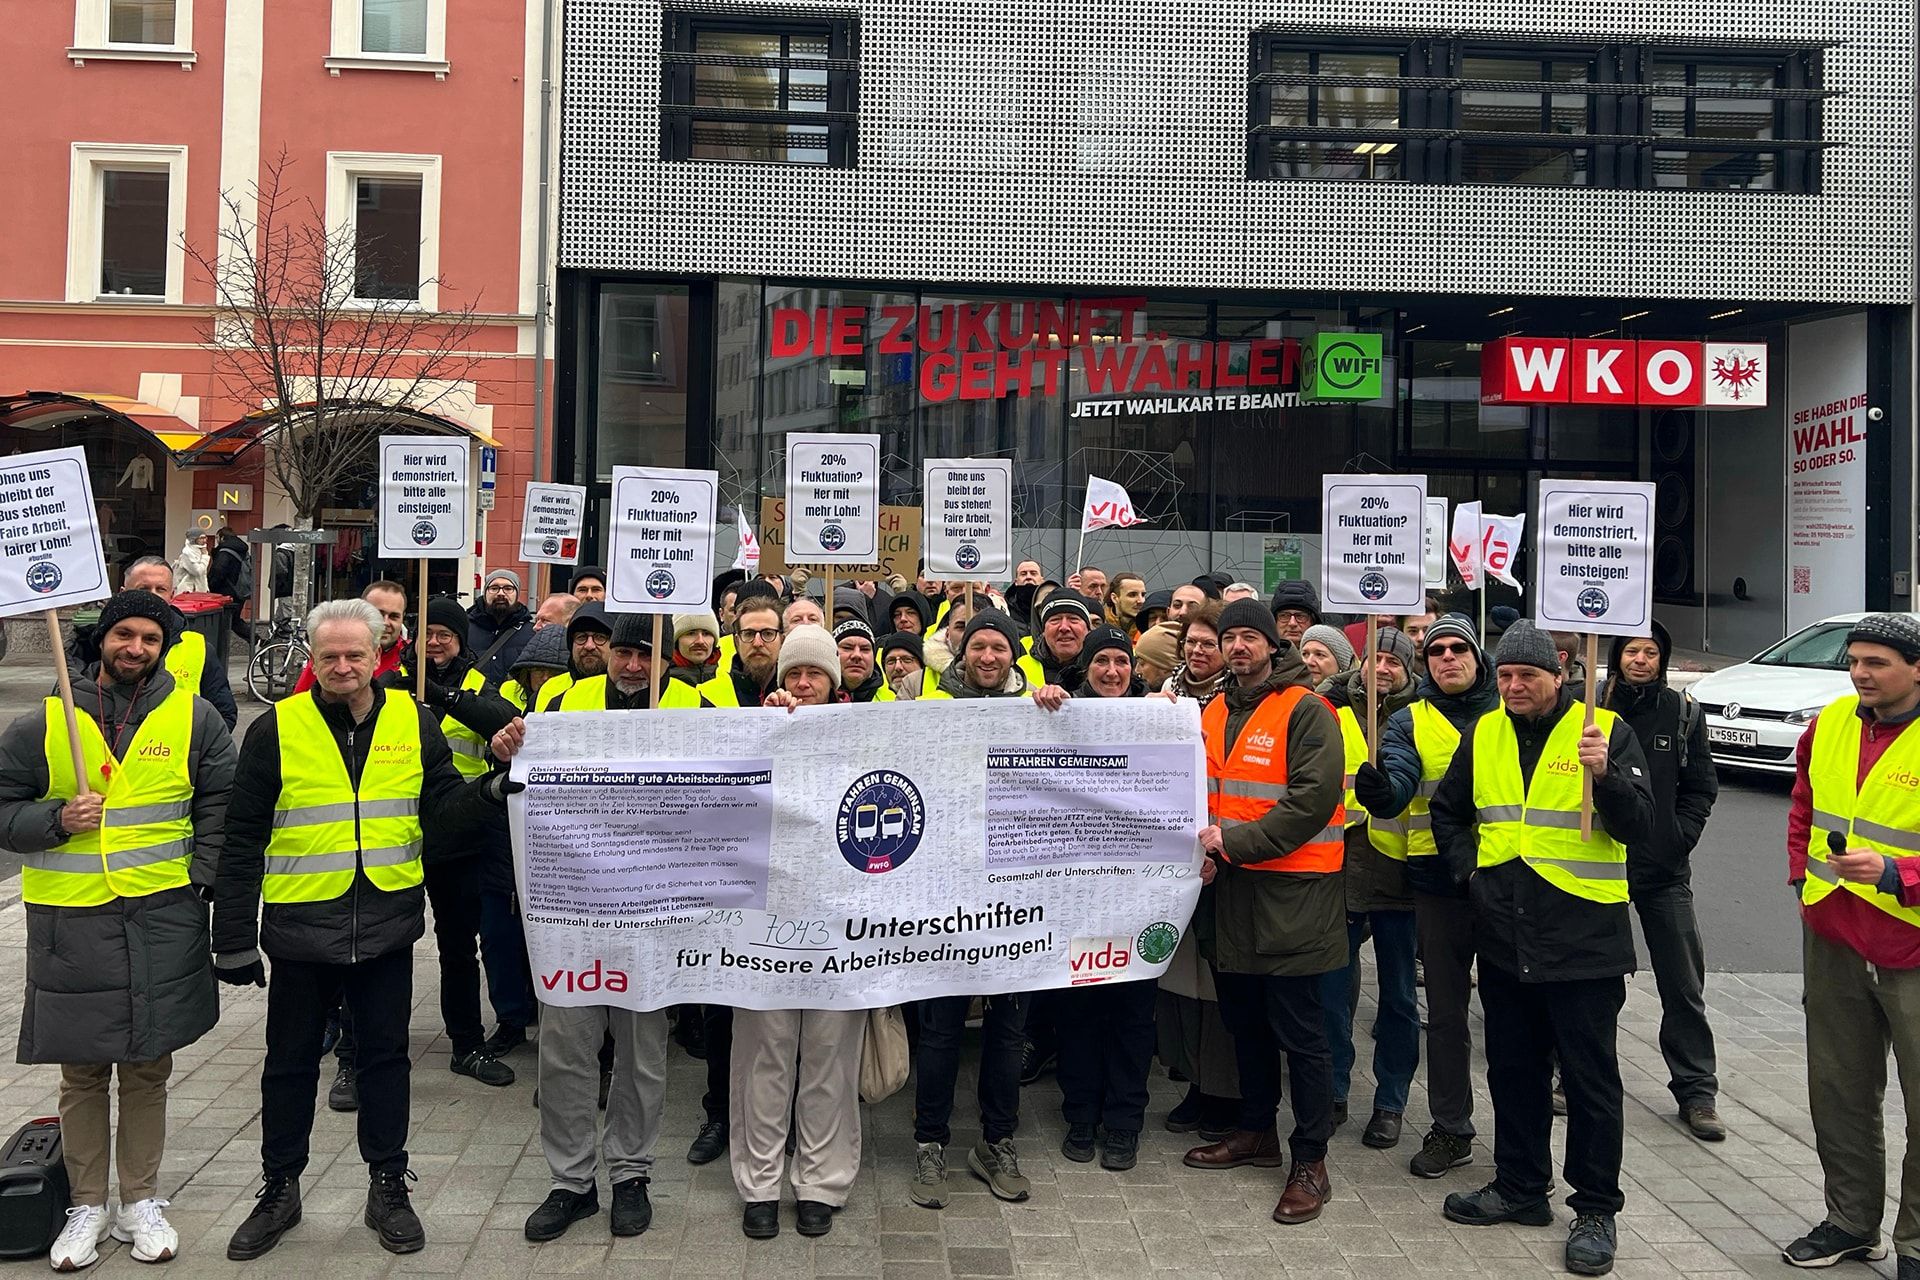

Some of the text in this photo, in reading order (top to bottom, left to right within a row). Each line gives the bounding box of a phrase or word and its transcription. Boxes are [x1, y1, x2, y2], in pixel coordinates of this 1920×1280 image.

[772, 296, 1147, 357] DIE ZUKUNFT
[1334, 358, 1380, 374] WIFI
[1510, 346, 1693, 396] WKO
[920, 349, 1067, 402] GEHT
[1070, 400, 1124, 418] JETZT
[1794, 393, 1868, 425] SIE HABEN DIE
[1794, 415, 1868, 456] WAHL.
[404, 454, 446, 466] Hier wird
[820, 454, 846, 466] 20%
[1794, 448, 1856, 474] SO ODER SO.
[28, 468, 50, 480] uns
[392, 470, 458, 482] demonstriert,
[801, 471, 862, 482] Fluktuation?
[948, 472, 986, 482] Ohne uns
[0, 486, 54, 504] bleibt der
[223, 490, 240, 505] N
[404, 486, 446, 498] bitte alle
[650, 490, 680, 504] 20%
[814, 488, 850, 500] Her mit
[947, 486, 986, 496] bleibt der
[541, 495, 570, 504] Hier wird
[944, 500, 992, 510] Bus stehen!
[1360, 497, 1390, 510] 20%
[0, 500, 66, 521] Bus stehen!
[398, 502, 451, 514] einsteigen!
[532, 504, 576, 516] demonstriert,
[805, 505, 860, 516] mehr Lohn!
[1568, 504, 1624, 519] Hier wird
[539, 516, 568, 526] bitte alle
[628, 508, 698, 524] Fluktuation?
[944, 514, 992, 524] Faire Arbeit,
[1338, 515, 1408, 528] Fluktuation?
[0, 518, 70, 540] Faire Arbeit,
[534, 526, 570, 536] einsteigen!
[641, 528, 682, 542] Her mit
[945, 527, 991, 538] fairer Lohn!
[1554, 524, 1638, 541] demonstriert,
[4, 535, 72, 557] fairer Lohn!
[1352, 533, 1393, 546] Her mit
[630, 547, 694, 562] mehr Lohn!
[1344, 552, 1405, 565] mehr Lohn!
[1568, 544, 1622, 559] bitte alle
[1560, 562, 1628, 580] einsteigen!
[1247, 728, 1275, 748] vida
[1721, 730, 1738, 742] 595
[1740, 732, 1752, 744] KH
[139, 739, 170, 756] vida
[392, 742, 412, 752] vida
[988, 756, 1127, 767] WIR FAHREN GEMEINSAM!
[1548, 756, 1578, 772] vida
[530, 771, 771, 786] Gute Fahrt braucht gute Arbeitsbedingungen!
[1887, 765, 1919, 786] vida
[660, 802, 699, 810] Deswegen
[838, 774, 922, 843] WIR FAHREN GEMEINSAM
[1017, 822, 1037, 830] allein
[1112, 822, 1166, 830] Streckennetzes
[1028, 814, 1062, 822] brauchen
[1104, 815, 1161, 823] Verkehrswende
[869, 862, 890, 870] #WFG
[1141, 864, 1191, 878] 4130
[988, 866, 1135, 883] Gesamtzahl der Unterschriften:
[526, 913, 694, 929] Gesamtzahl der Unterschriften:
[698, 910, 743, 926] 2913
[845, 900, 1044, 942] Unterschriften
[764, 913, 830, 944] 7043
[676, 932, 1054, 974] für bessere Arbeitsbedingungen!
[1070, 942, 1128, 972] vida
[541, 959, 628, 993] vida
